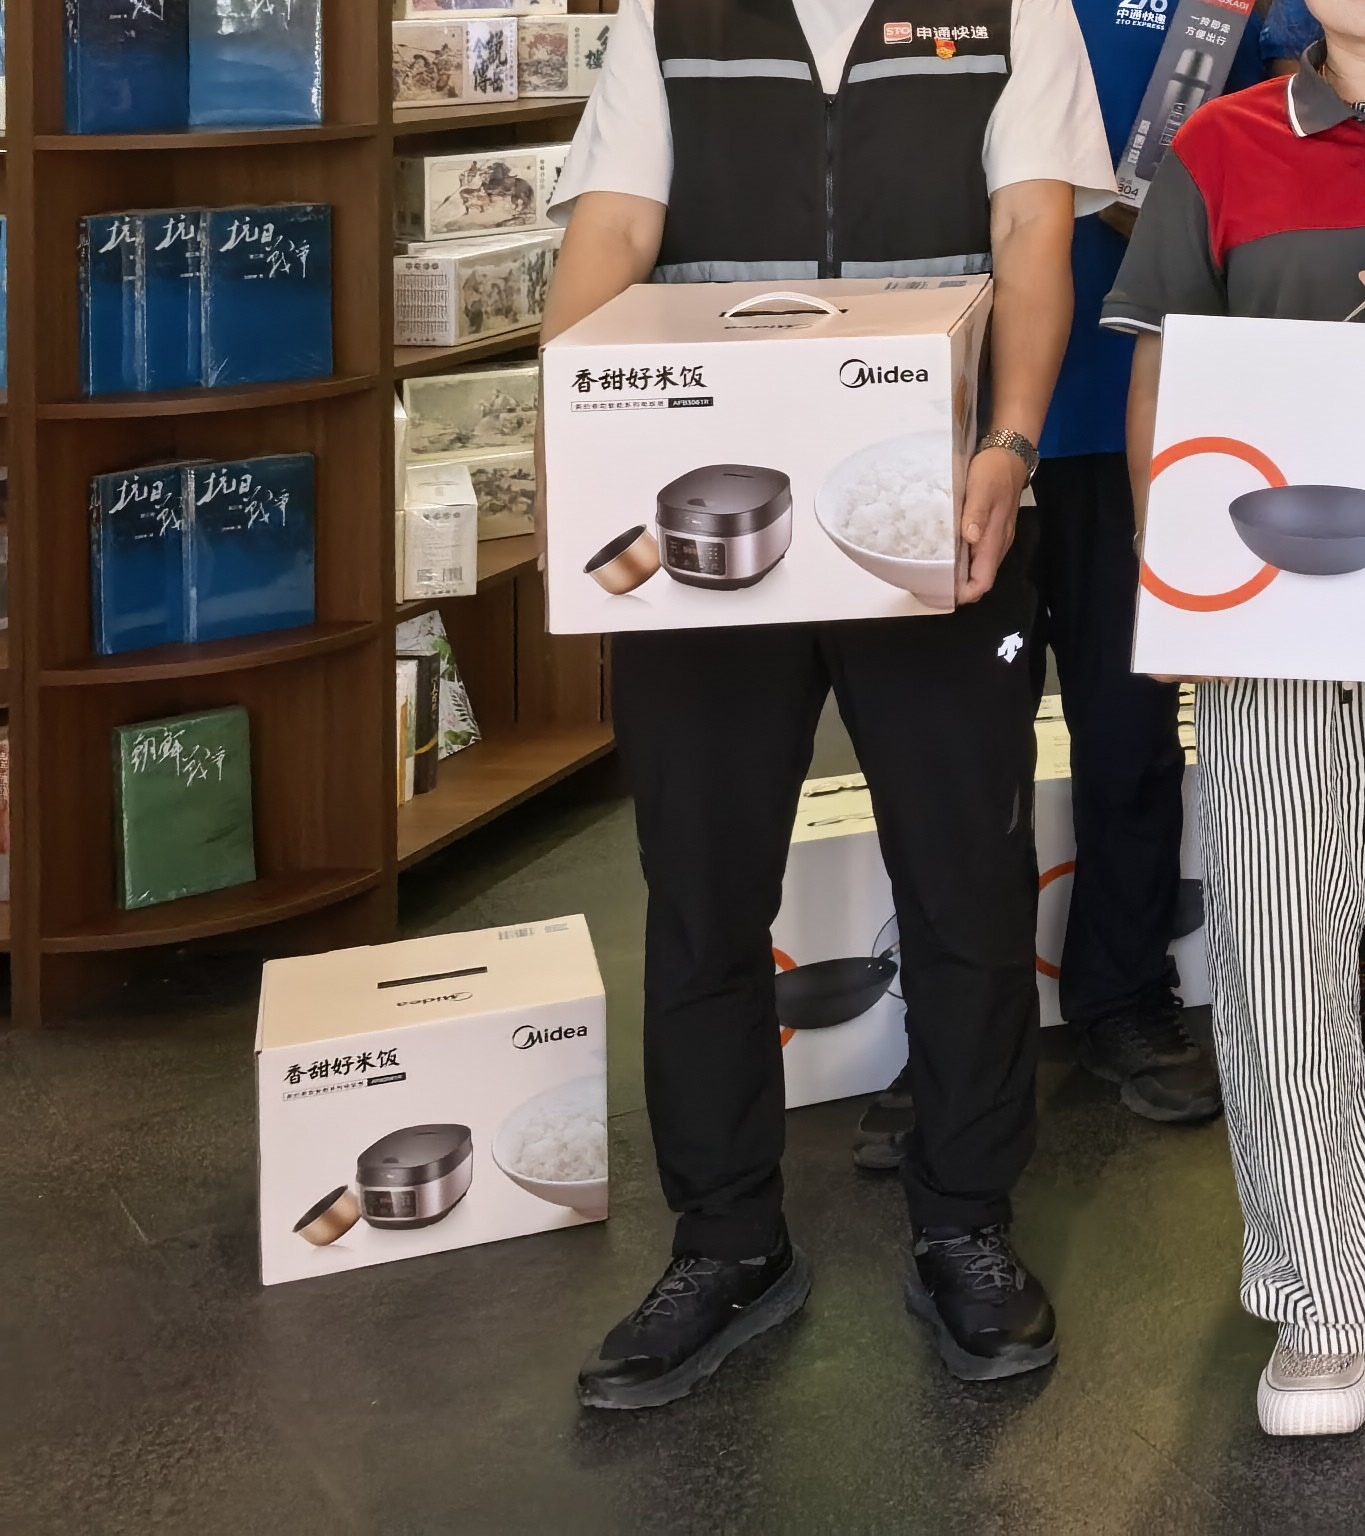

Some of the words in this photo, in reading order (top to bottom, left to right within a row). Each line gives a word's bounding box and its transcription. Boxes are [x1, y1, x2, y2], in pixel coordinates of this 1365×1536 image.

[1116, 8, 1166, 25] 中通快递
[916, 25, 989, 41] 申通快递
[571, 365, 708, 393] 香甜好米饭
[839, 358, 930, 389] Midea
[512, 1023, 589, 1050] Midea
[282, 1047, 401, 1086] 香甜好米饭
